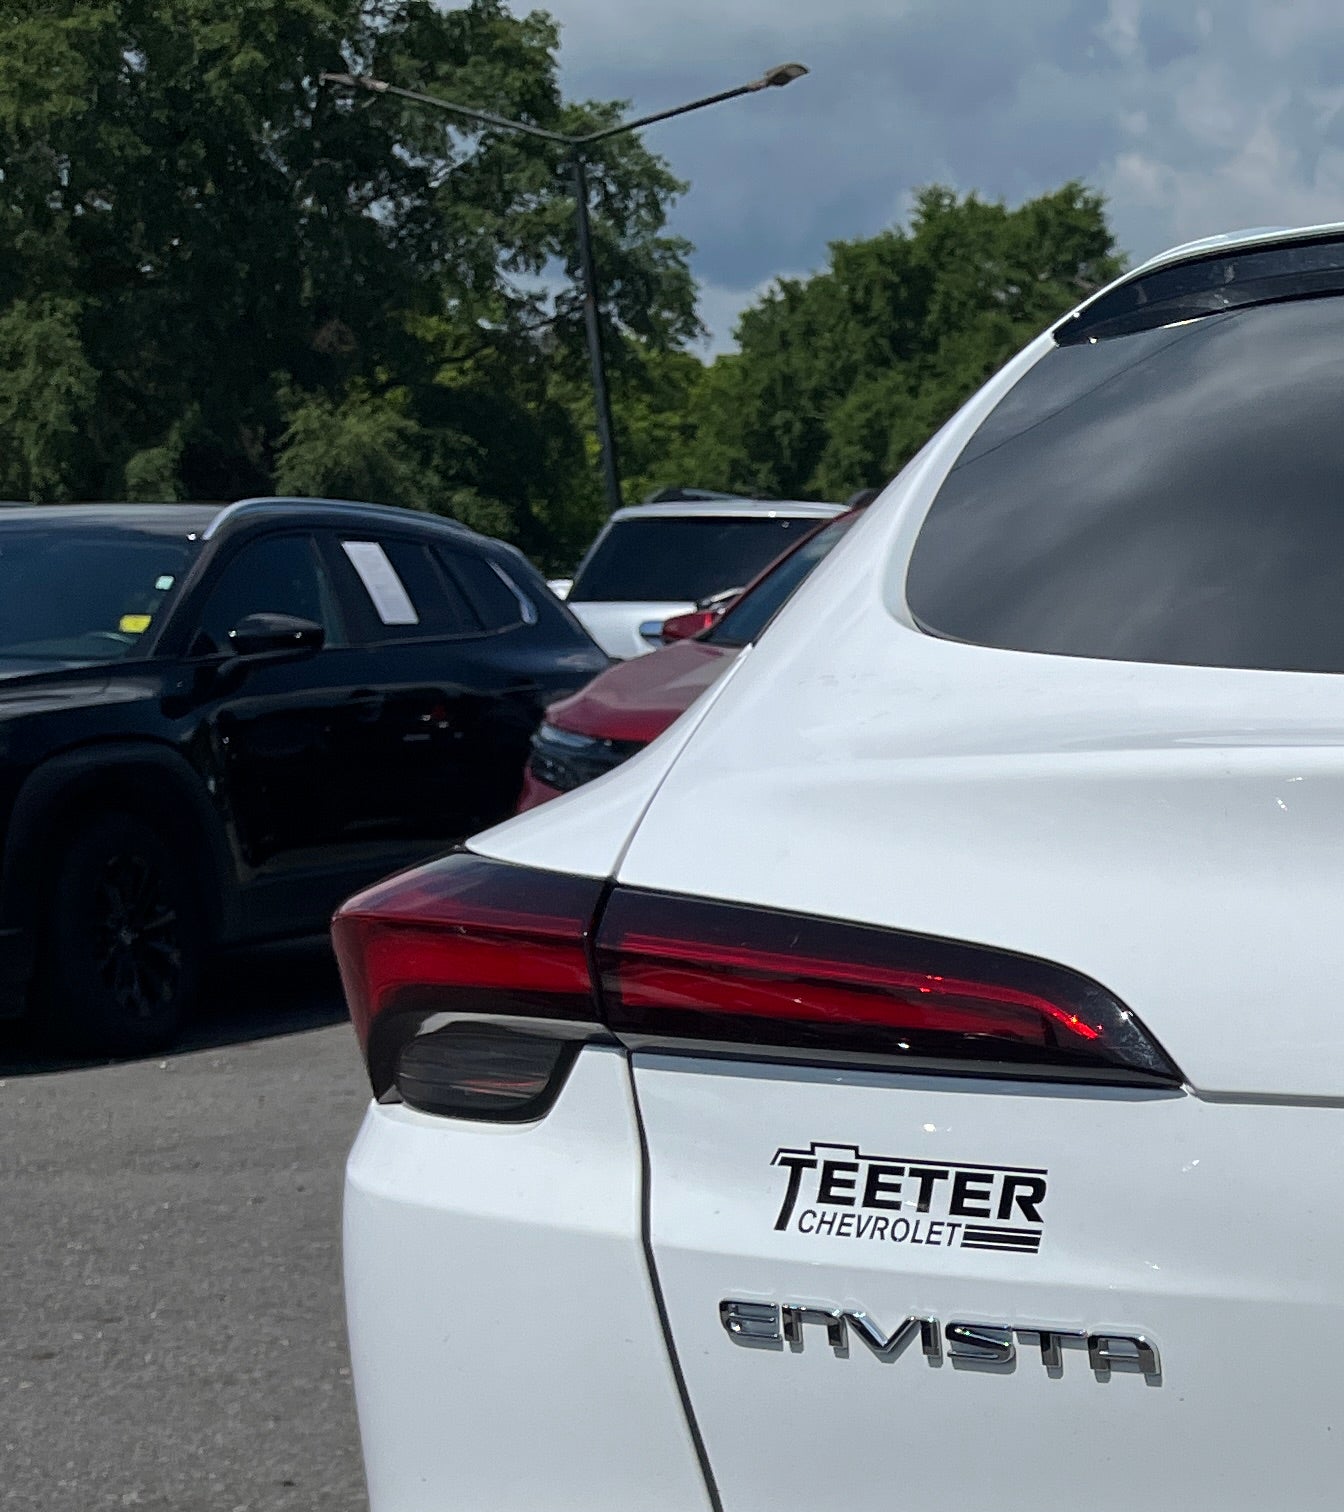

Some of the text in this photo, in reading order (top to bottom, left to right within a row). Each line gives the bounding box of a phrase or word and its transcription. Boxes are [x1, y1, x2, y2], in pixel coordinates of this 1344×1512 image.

[774, 1156, 1048, 1232] TEETER
[798, 1209, 963, 1247] CHEVROLET
[718, 1298, 1162, 1377] ENVISTA
